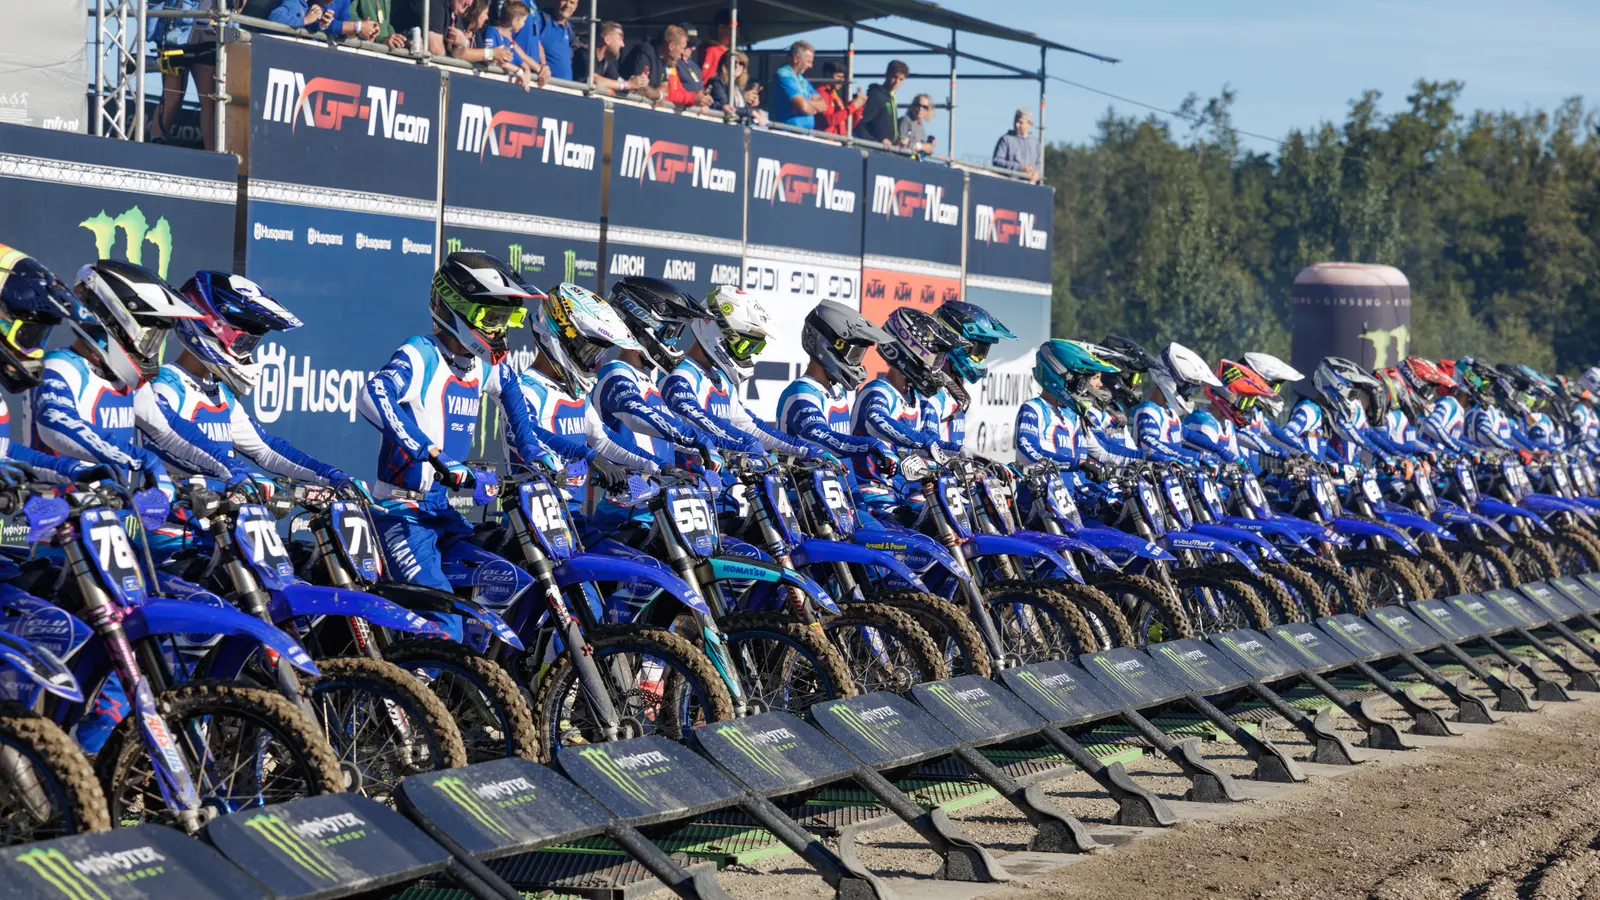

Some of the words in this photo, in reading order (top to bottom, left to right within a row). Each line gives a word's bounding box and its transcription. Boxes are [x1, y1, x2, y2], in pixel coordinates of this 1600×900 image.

[609, 253, 645, 277] AIROH
[663, 259, 696, 282] AIROH
[710, 264, 741, 286] AIROH
[746, 266, 779, 292] SIDI
[790, 271, 819, 296] SIDI
[828, 275, 857, 300] SIDI
[865, 278, 886, 300] KTM
[893, 281, 912, 302] KTM
[919, 284, 935, 304] KTM
[980, 372, 1019, 406] FOLLOW
[89, 524, 134, 572] 78
[722, 564, 767, 577] KOMATSU
[746, 726, 796, 748] MONSTER
[614, 749, 671, 771] MONSTER
[635, 764, 672, 779] ENERGY
[472, 776, 536, 800] MONSTER
[496, 792, 538, 809] ENERGY
[290, 811, 366, 840] MONSTER
[319, 829, 368, 848] ENERGY
[72, 846, 167, 876] MONSTER
[108, 865, 166, 884] ENERGY
